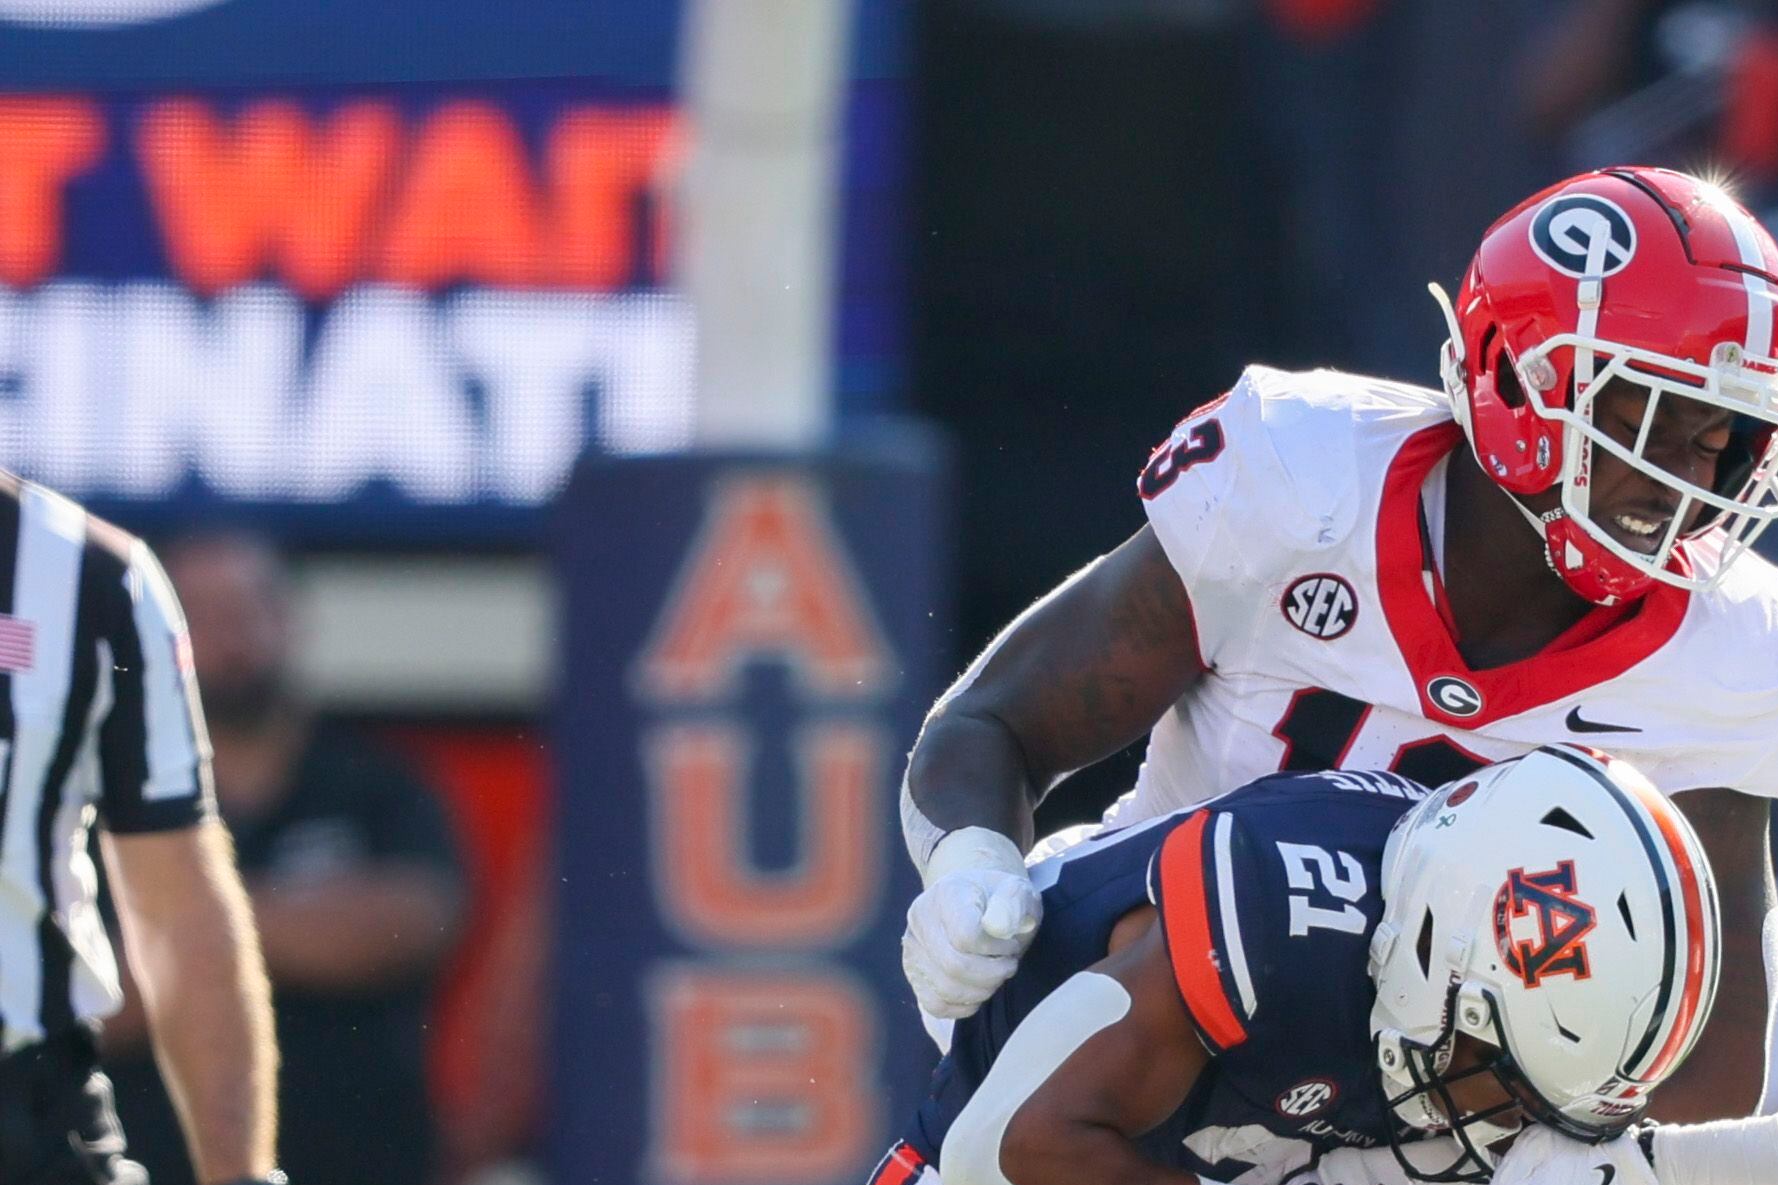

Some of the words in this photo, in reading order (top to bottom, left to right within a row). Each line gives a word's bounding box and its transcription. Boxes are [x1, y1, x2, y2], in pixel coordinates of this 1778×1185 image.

[1284, 575, 1355, 639] SEC
[1432, 679, 1481, 714] G
[1275, 840, 1368, 937] 21
[1279, 1081, 1333, 1117] SEC
